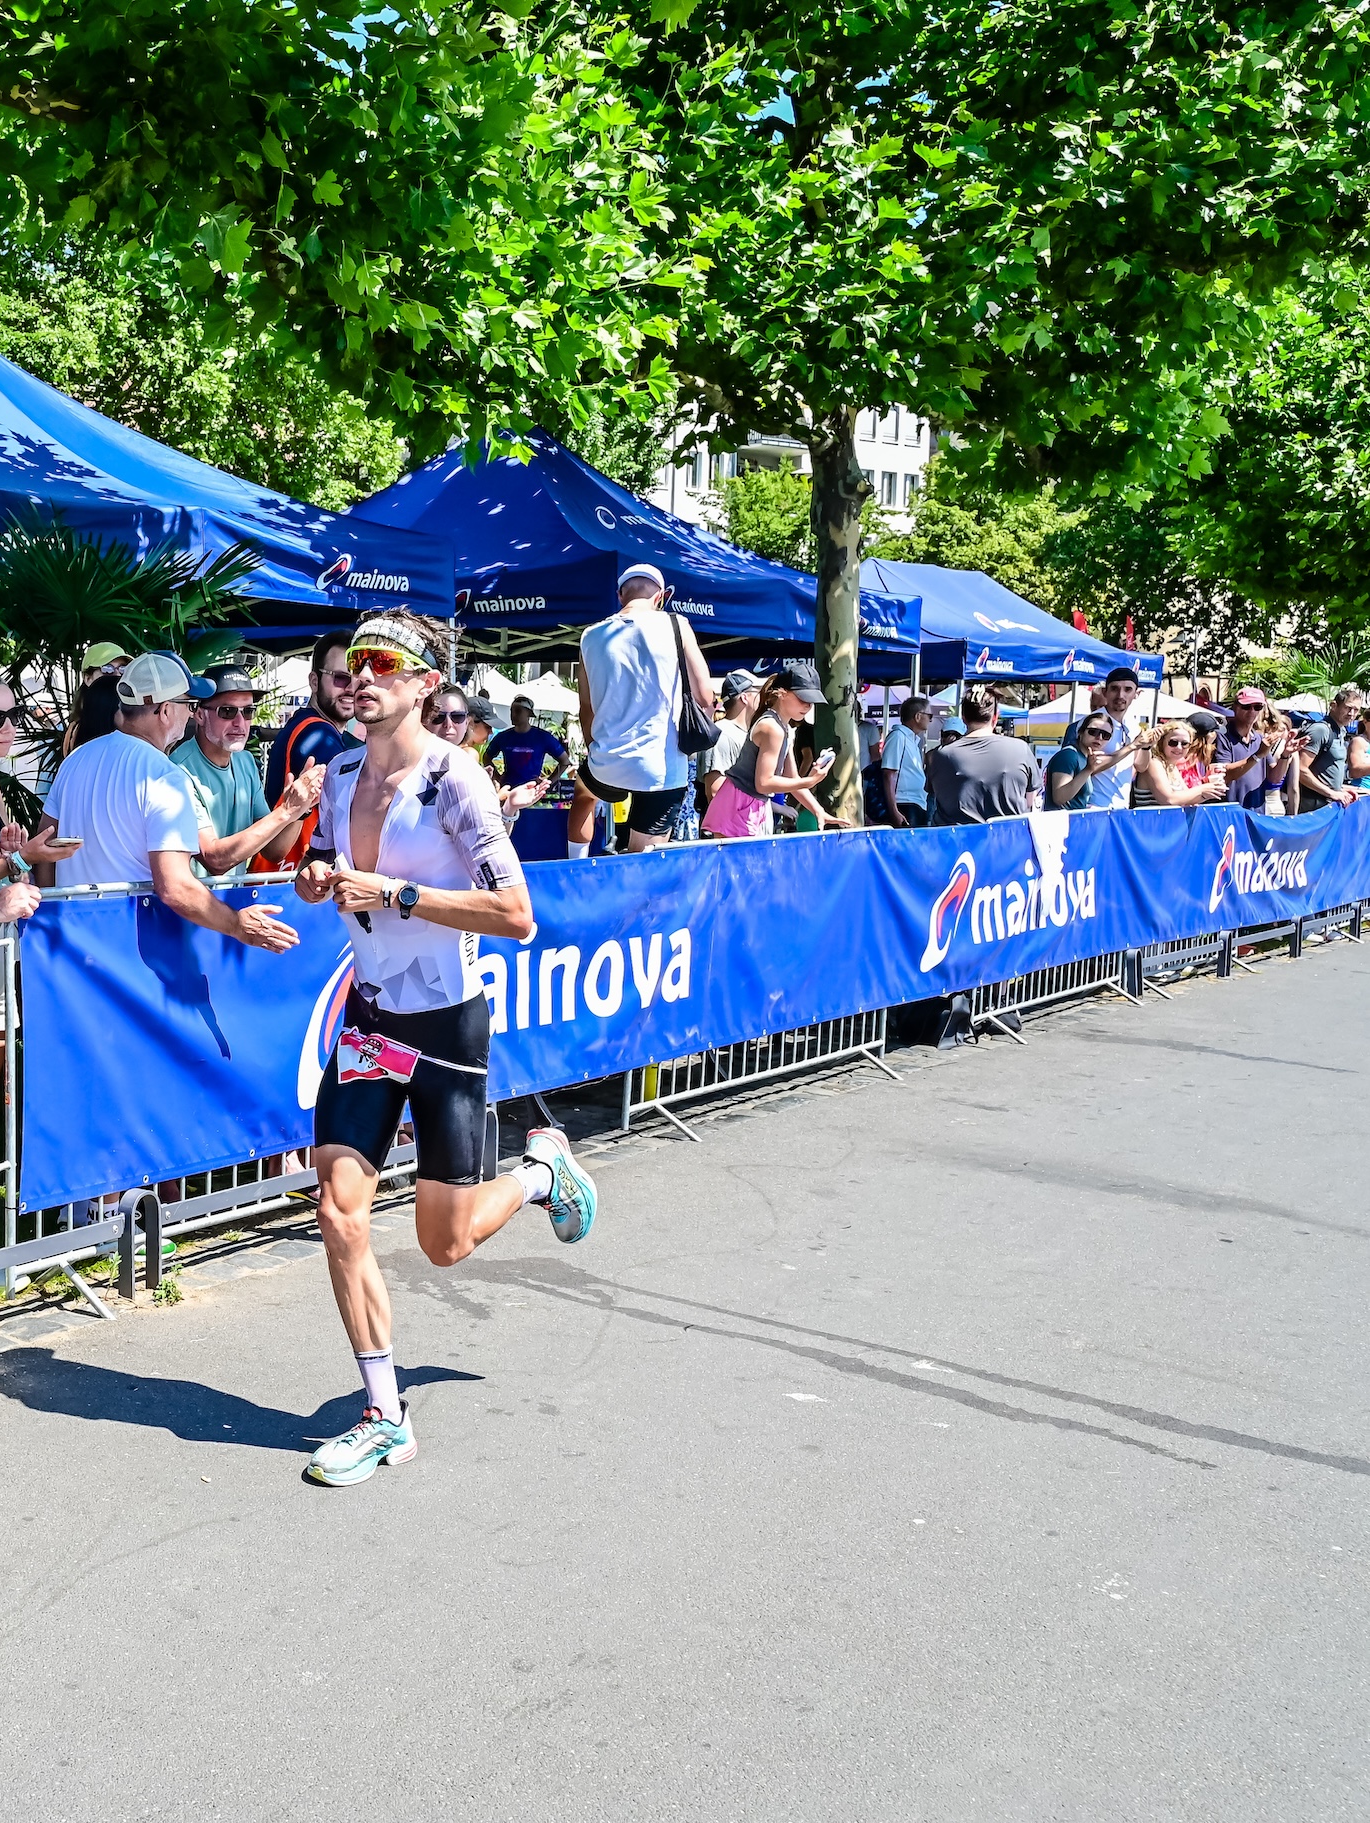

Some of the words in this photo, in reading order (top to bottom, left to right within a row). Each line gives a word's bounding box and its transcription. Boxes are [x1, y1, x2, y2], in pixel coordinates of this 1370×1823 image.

[345, 568, 410, 592] mainova
[473, 594, 547, 613] mainova
[671, 597, 716, 616] mainova
[477, 921, 692, 1036] ainova
[557, 1165, 579, 1197] HOKA
